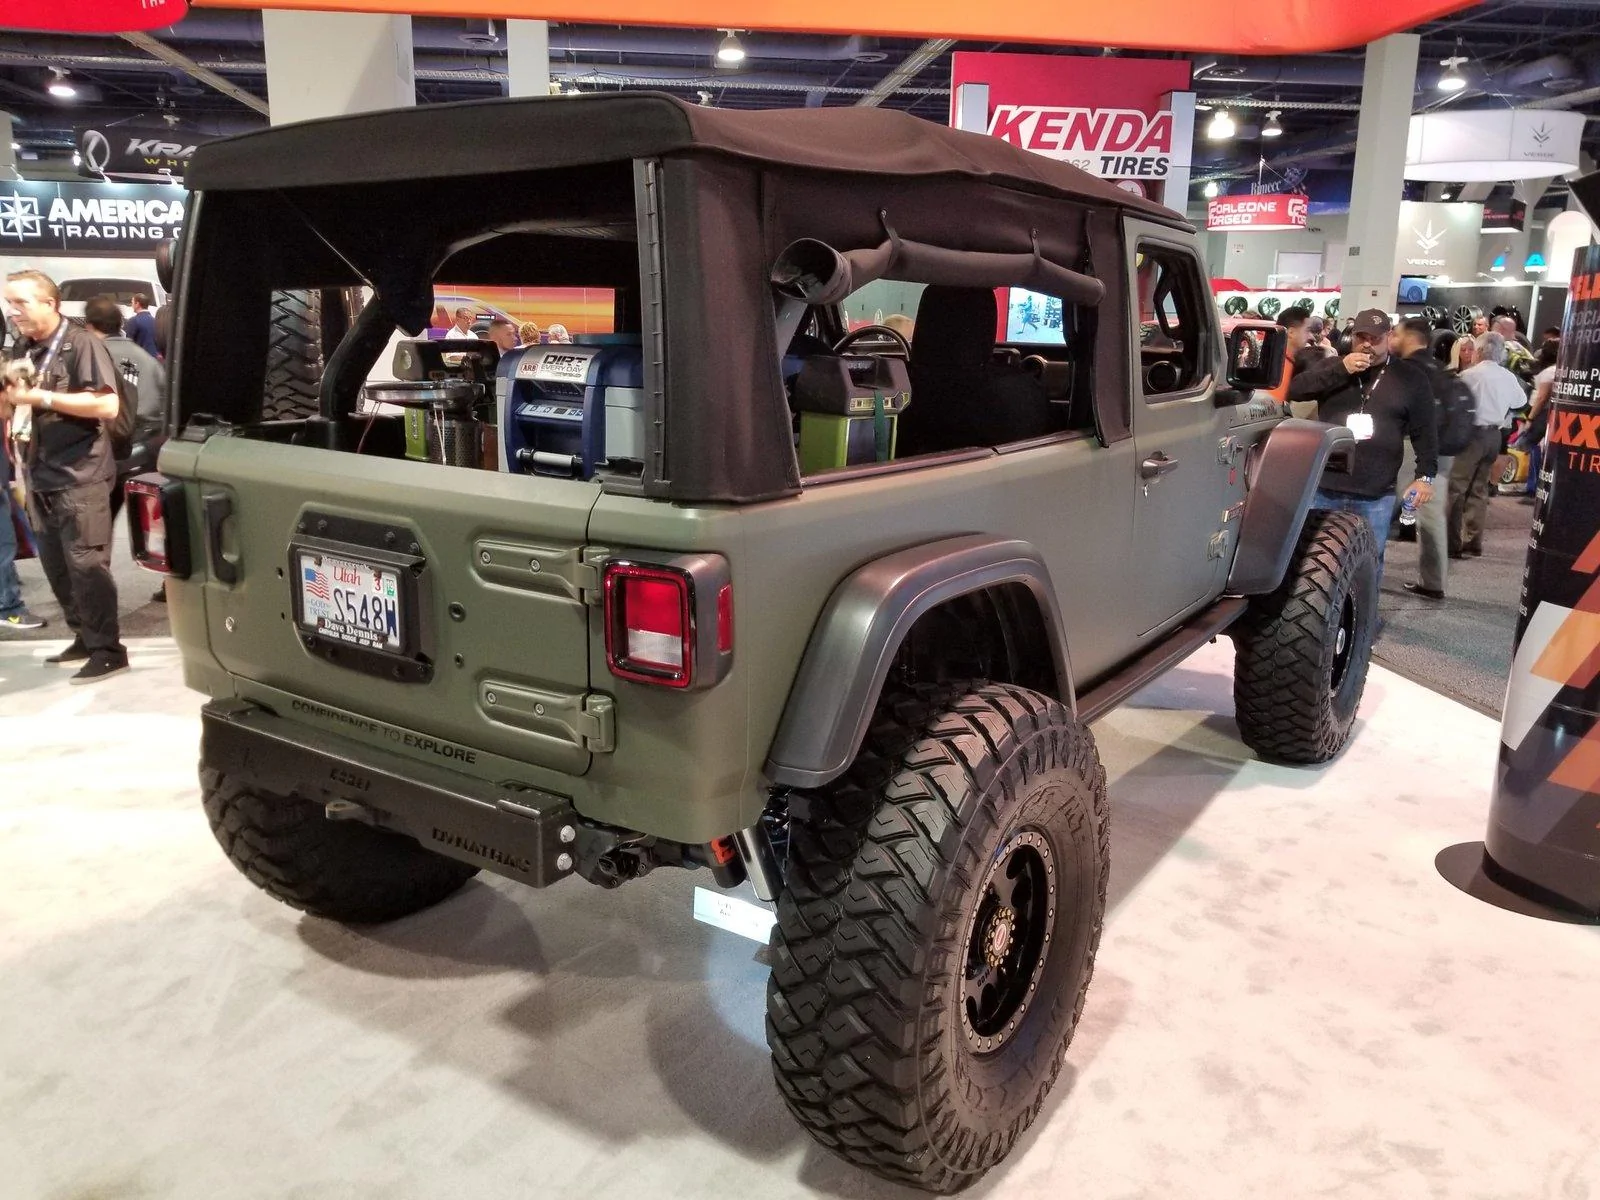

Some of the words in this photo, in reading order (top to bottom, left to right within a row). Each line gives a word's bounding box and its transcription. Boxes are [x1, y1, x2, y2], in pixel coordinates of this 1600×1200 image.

[989, 107, 1172, 153] KENDA
[1100, 156, 1169, 176] TIRES
[49, 225, 164, 239] TRADING
[1406, 258, 1445, 267] VERDE
[541, 363, 566, 371] EVERY
[567, 365, 583, 373] DAY
[543, 354, 587, 368] DIRT
[522, 364, 537, 373] ARB
[1569, 368, 1588, 381] new
[333, 566, 361, 586] Utah
[325, 619, 345, 632] Dave
[346, 625, 379, 641] Dennis
[292, 700, 378, 733] CONFIDENCE
[380, 727, 401, 743] TO
[403, 734, 477, 765] EXPLORE
